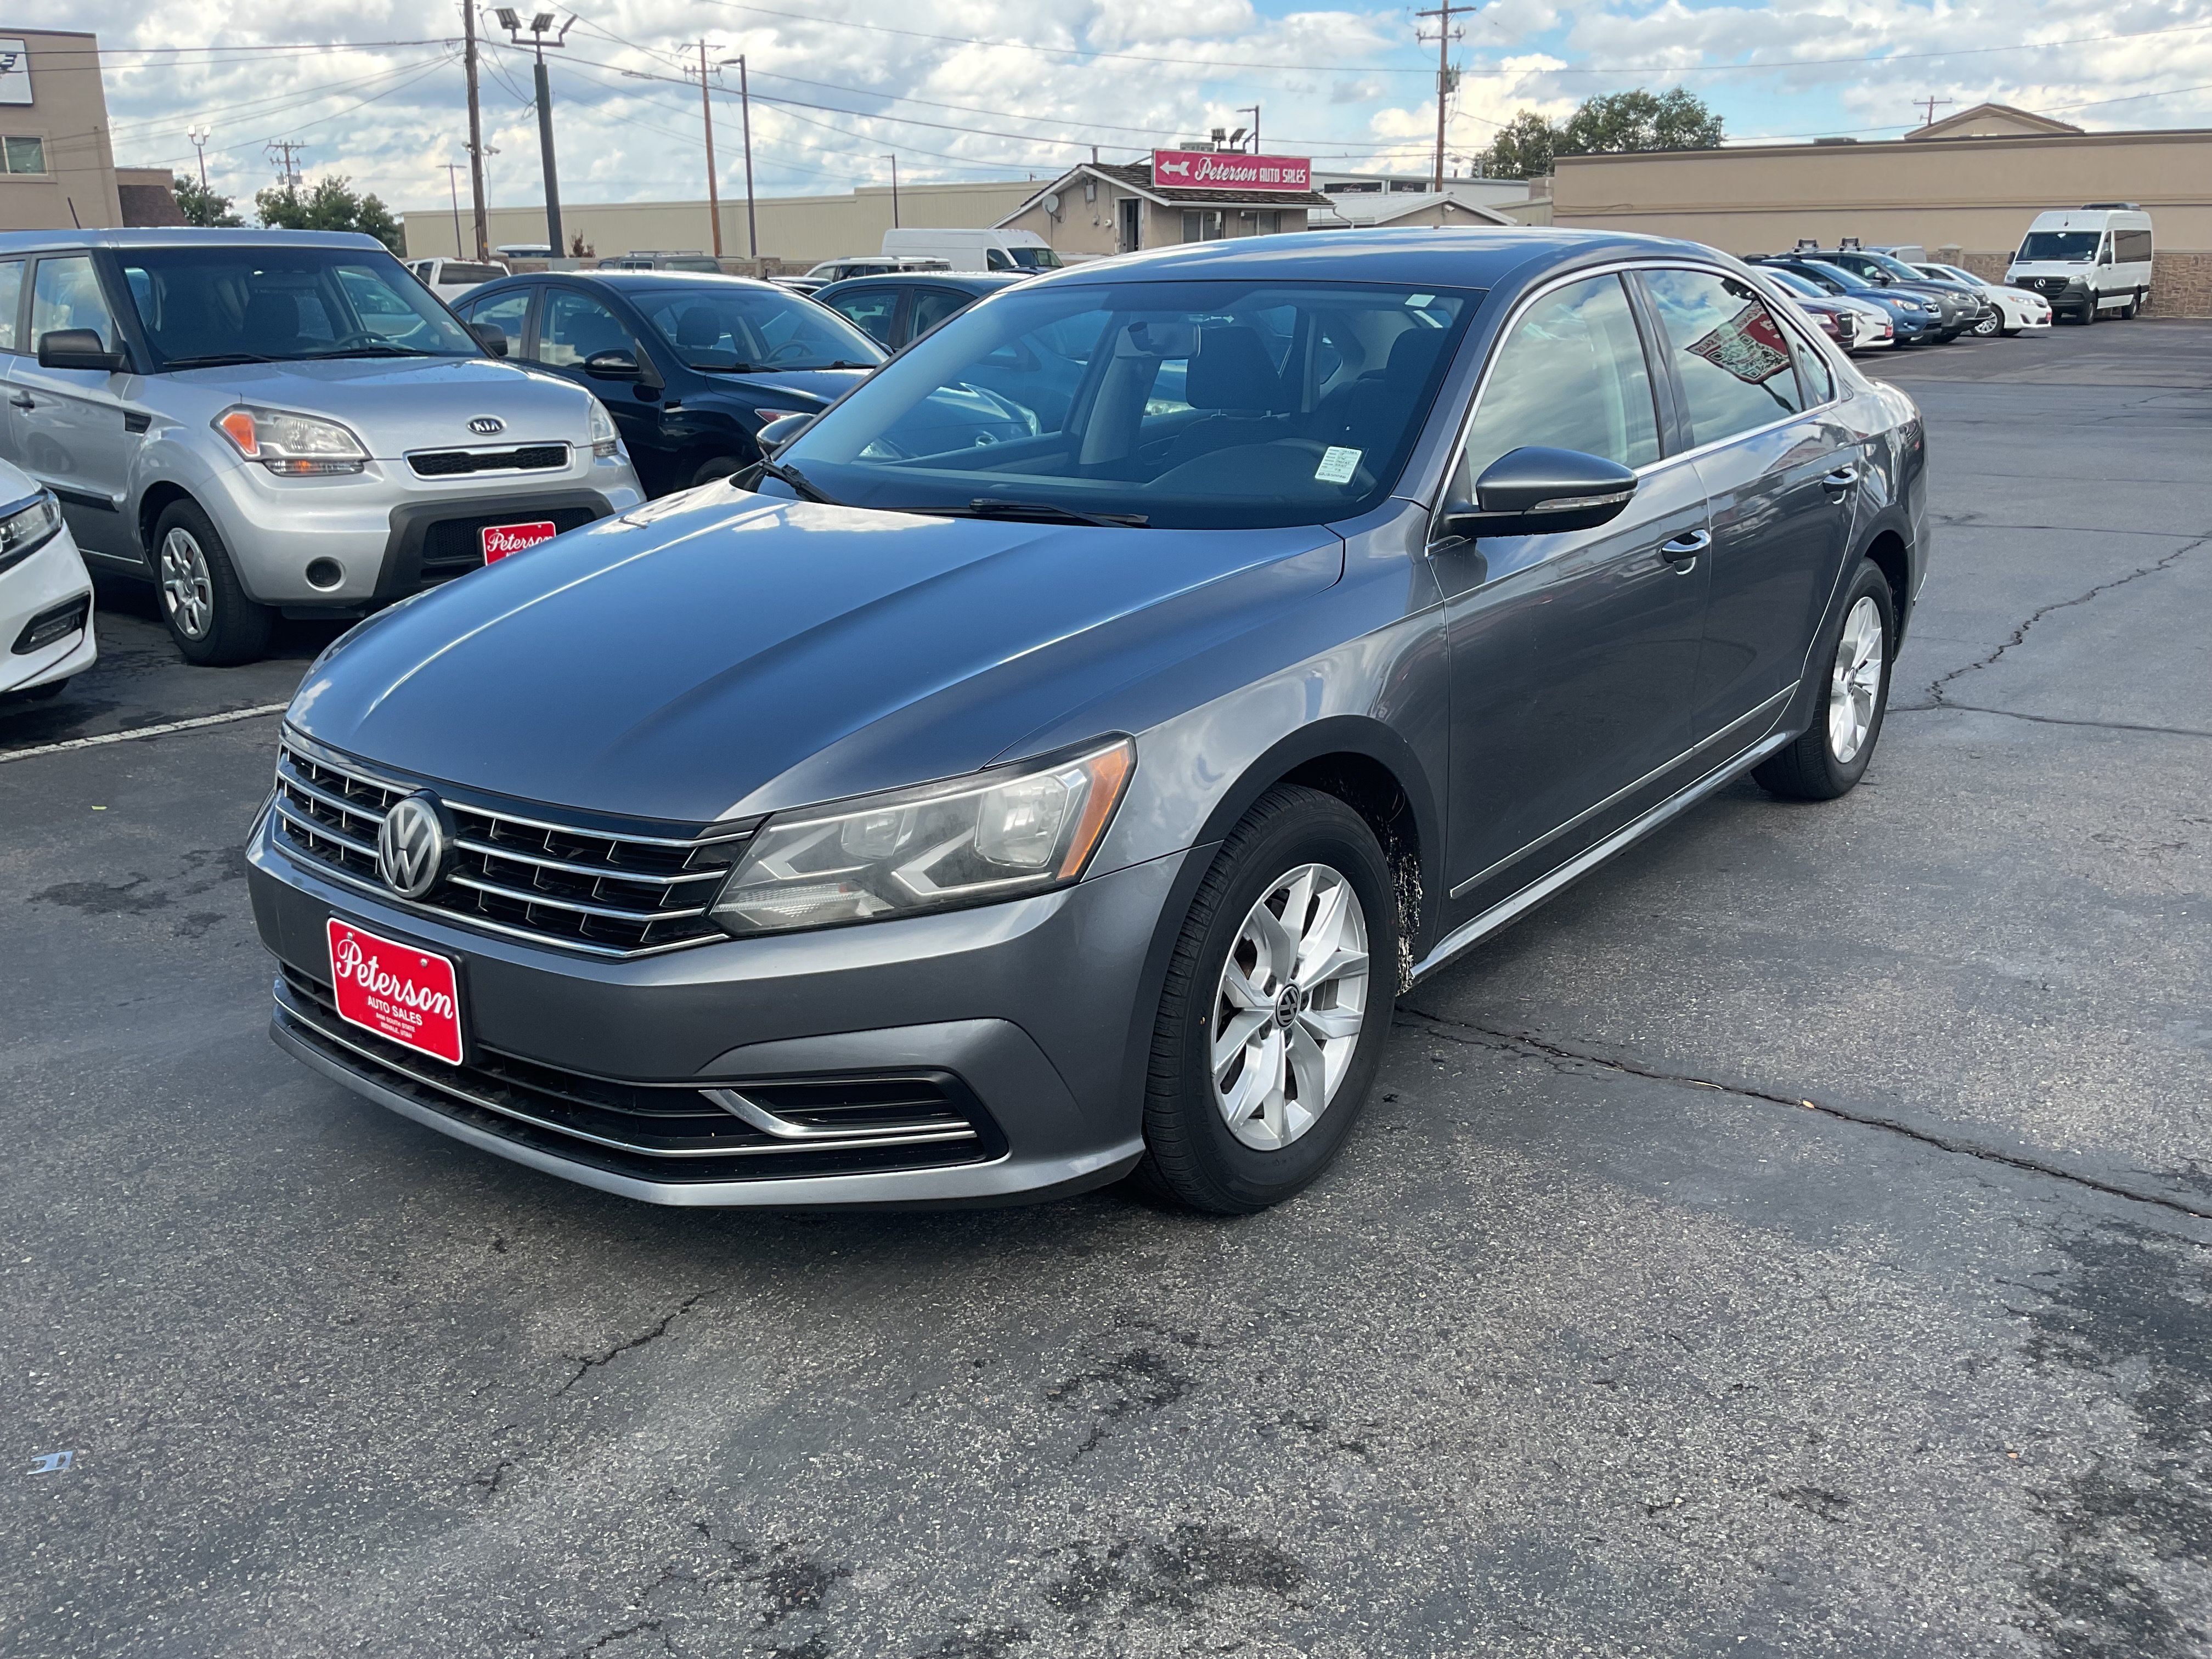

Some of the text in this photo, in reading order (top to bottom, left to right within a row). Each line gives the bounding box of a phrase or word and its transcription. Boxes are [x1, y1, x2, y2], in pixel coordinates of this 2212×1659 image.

[1194, 156, 1306, 184] Peterson AUTO SALES
[473, 420, 500, 431] KIA
[336, 939, 454, 1019] Peterson
[367, 995, 390, 1013] AUTO
[392, 1005, 422, 1026] SALES
